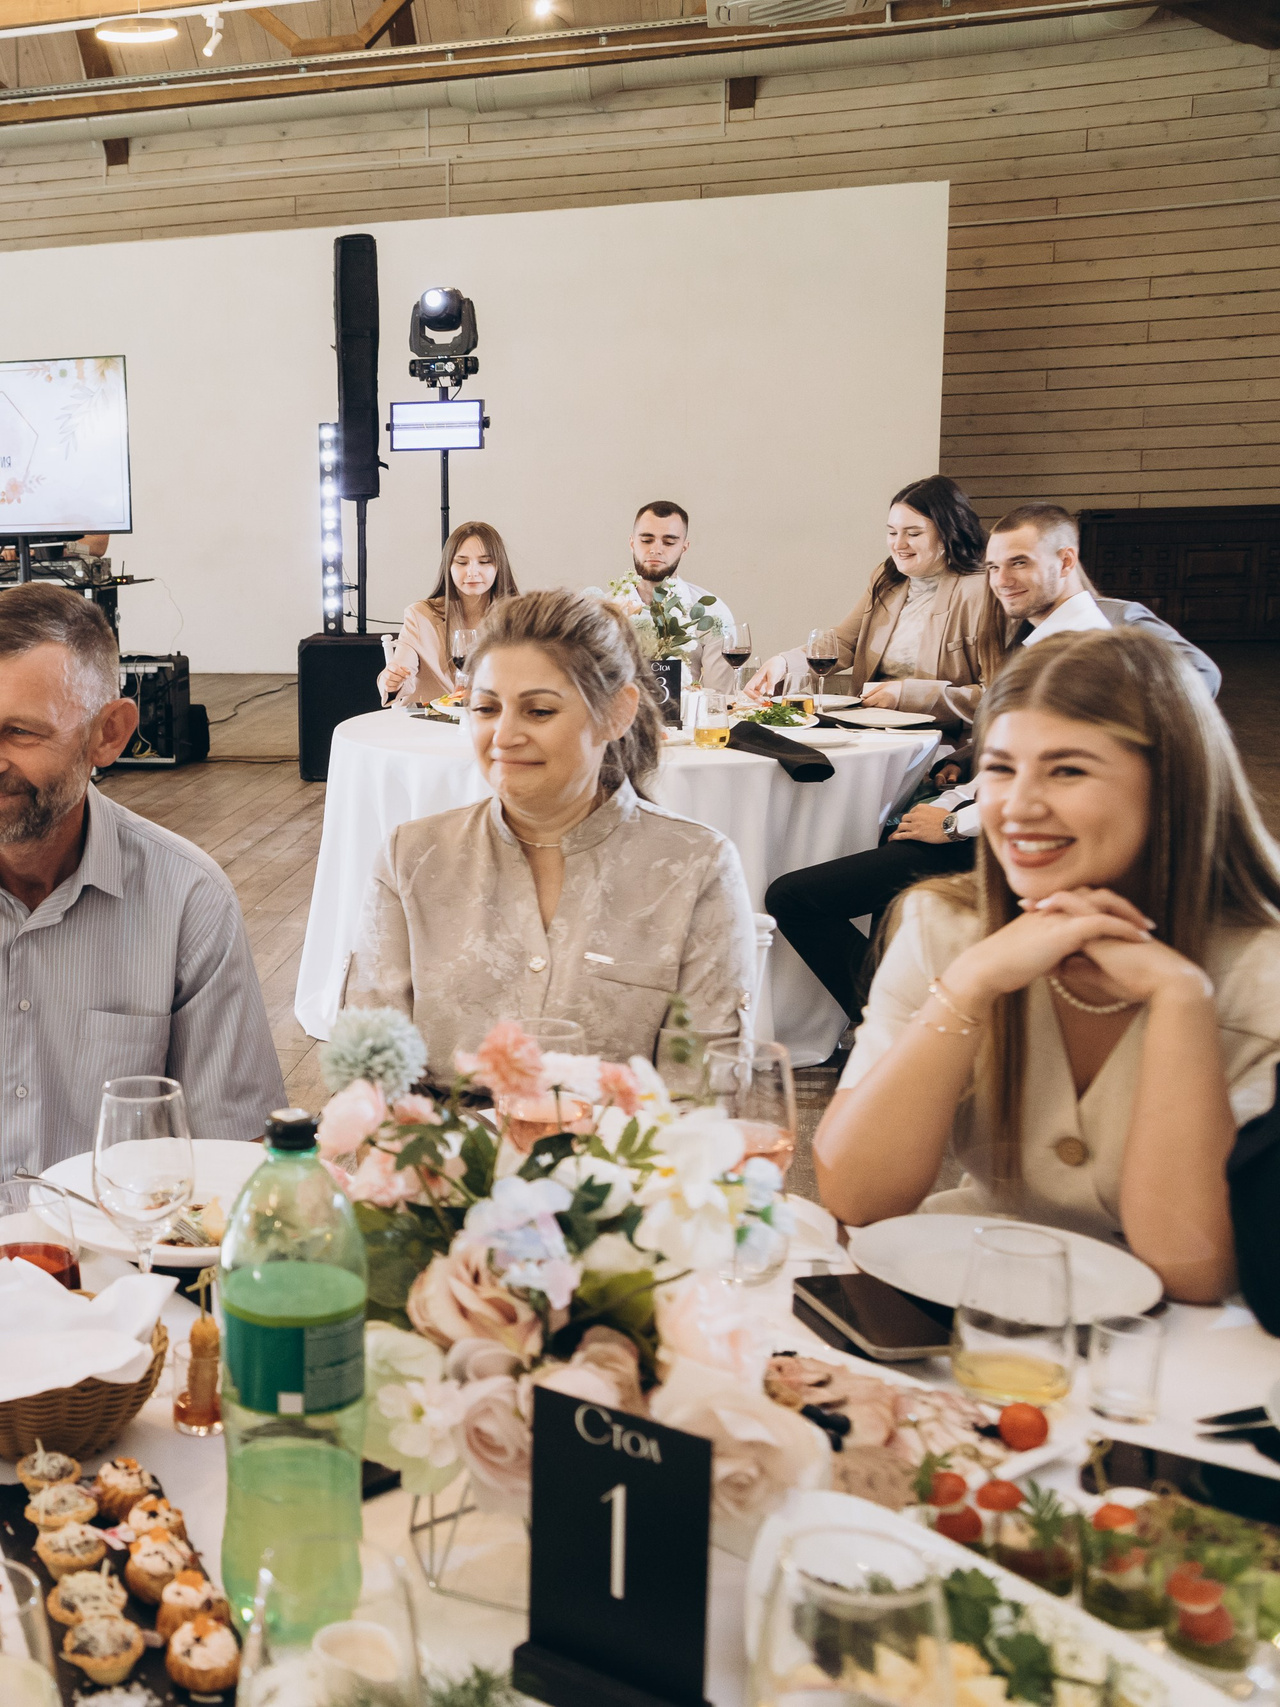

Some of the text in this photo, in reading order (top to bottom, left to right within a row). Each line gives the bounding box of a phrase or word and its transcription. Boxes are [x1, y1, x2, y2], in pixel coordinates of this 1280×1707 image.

[651, 661, 671, 672] Стол
[655, 676, 670, 705] 3
[574, 1403, 663, 1465] Стол
[600, 1483, 627, 1601] 1
